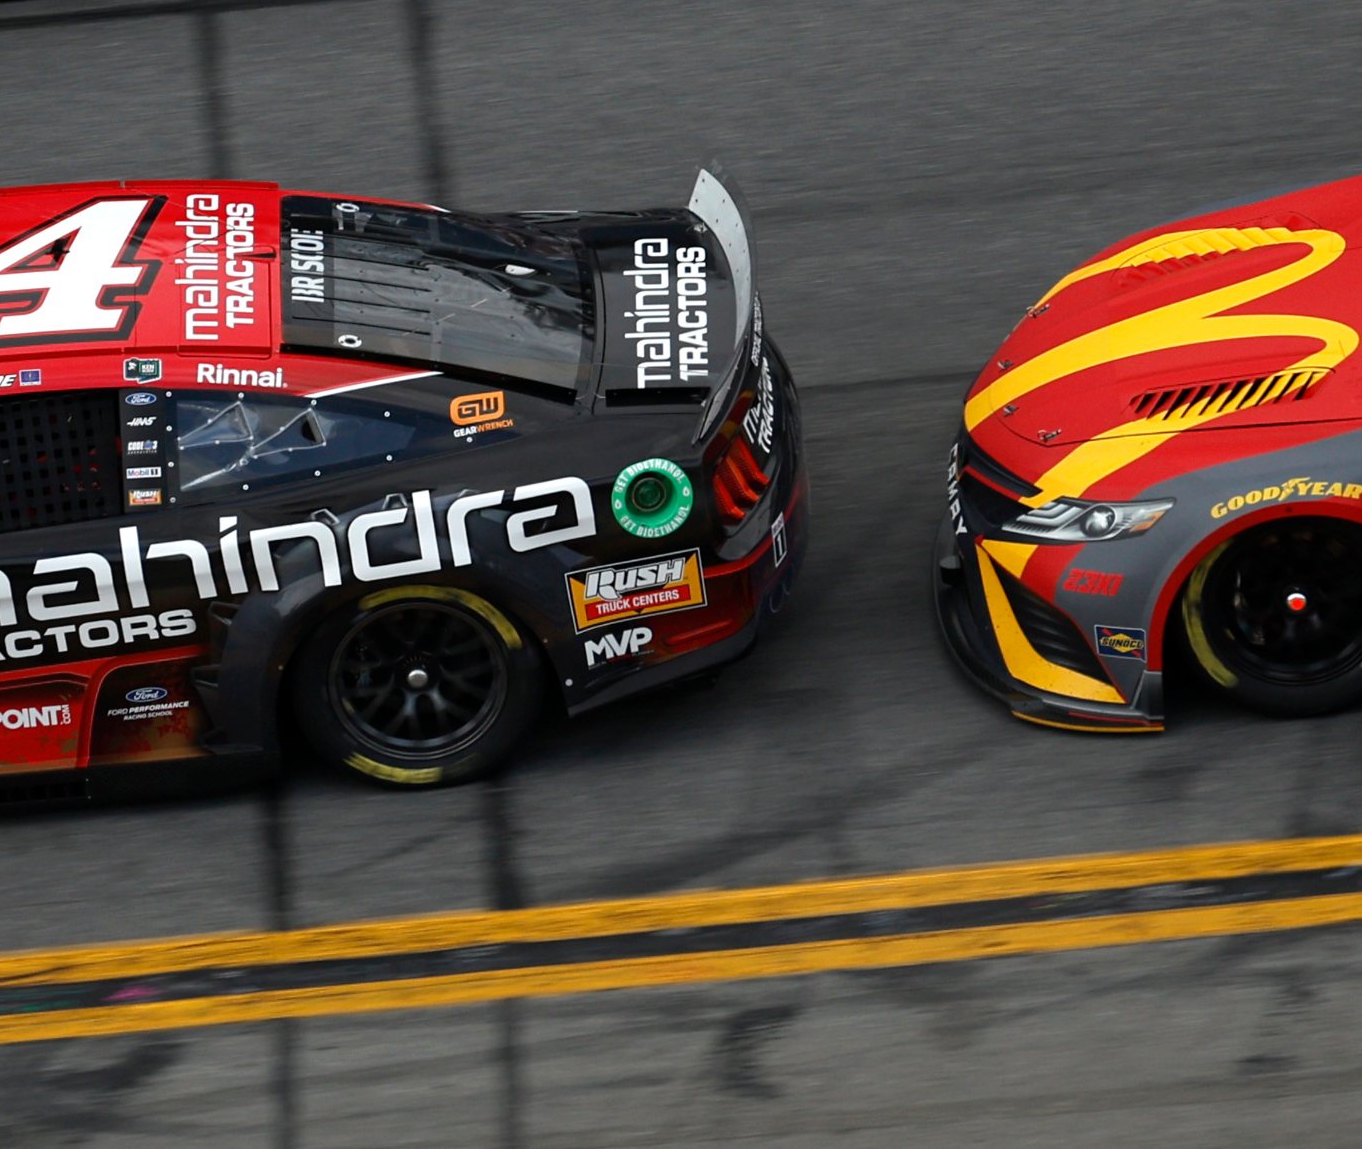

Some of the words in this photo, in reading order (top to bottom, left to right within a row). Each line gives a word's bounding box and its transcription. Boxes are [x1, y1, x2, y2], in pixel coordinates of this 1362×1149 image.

[174, 194, 221, 342] mahindra
[225, 202, 255, 329] TRACTORS
[623, 237, 671, 389] mahindra
[677, 246, 709, 382] TRACTORS
[196, 362, 283, 389] Rinnai
[453, 419, 514, 438] GEARWRENCH
[128, 468, 150, 477] Mobil
[585, 557, 686, 602] RUSH
[1063, 568, 1124, 597] 23XI
[596, 598, 630, 616] TRUCK
[632, 589, 680, 609] CENTERS
[584, 626, 654, 667] MVP
[1100, 636, 1145, 650] SUNOCO
[107, 708, 128, 717] FORD
[128, 700, 190, 714] PERFORMANCE
[123, 712, 147, 721] RACING
[148, 710, 173, 719] SCHOOL
